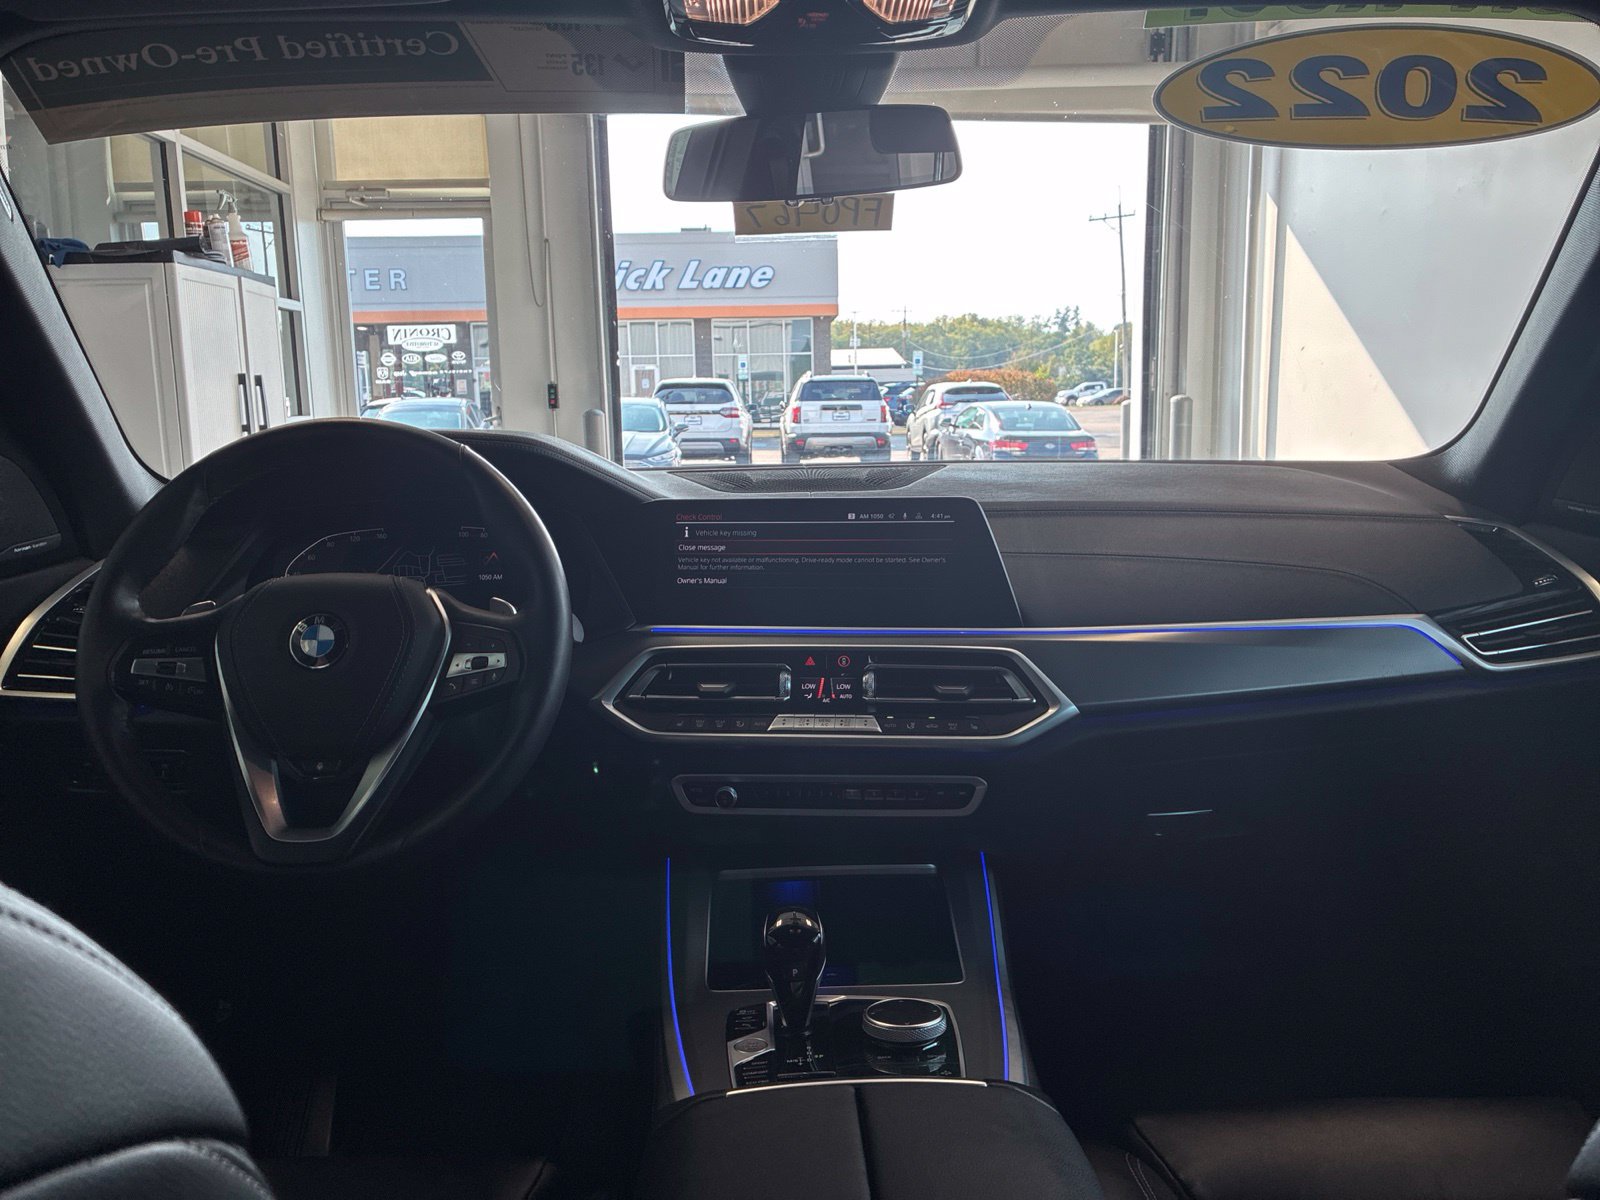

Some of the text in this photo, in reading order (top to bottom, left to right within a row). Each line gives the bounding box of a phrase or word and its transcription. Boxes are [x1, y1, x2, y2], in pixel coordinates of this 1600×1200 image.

[615, 259, 775, 291] ick Lane
[720, 530, 731, 538] key
[732, 530, 757, 538] missing
[478, 573, 503, 581] 1050 AM
